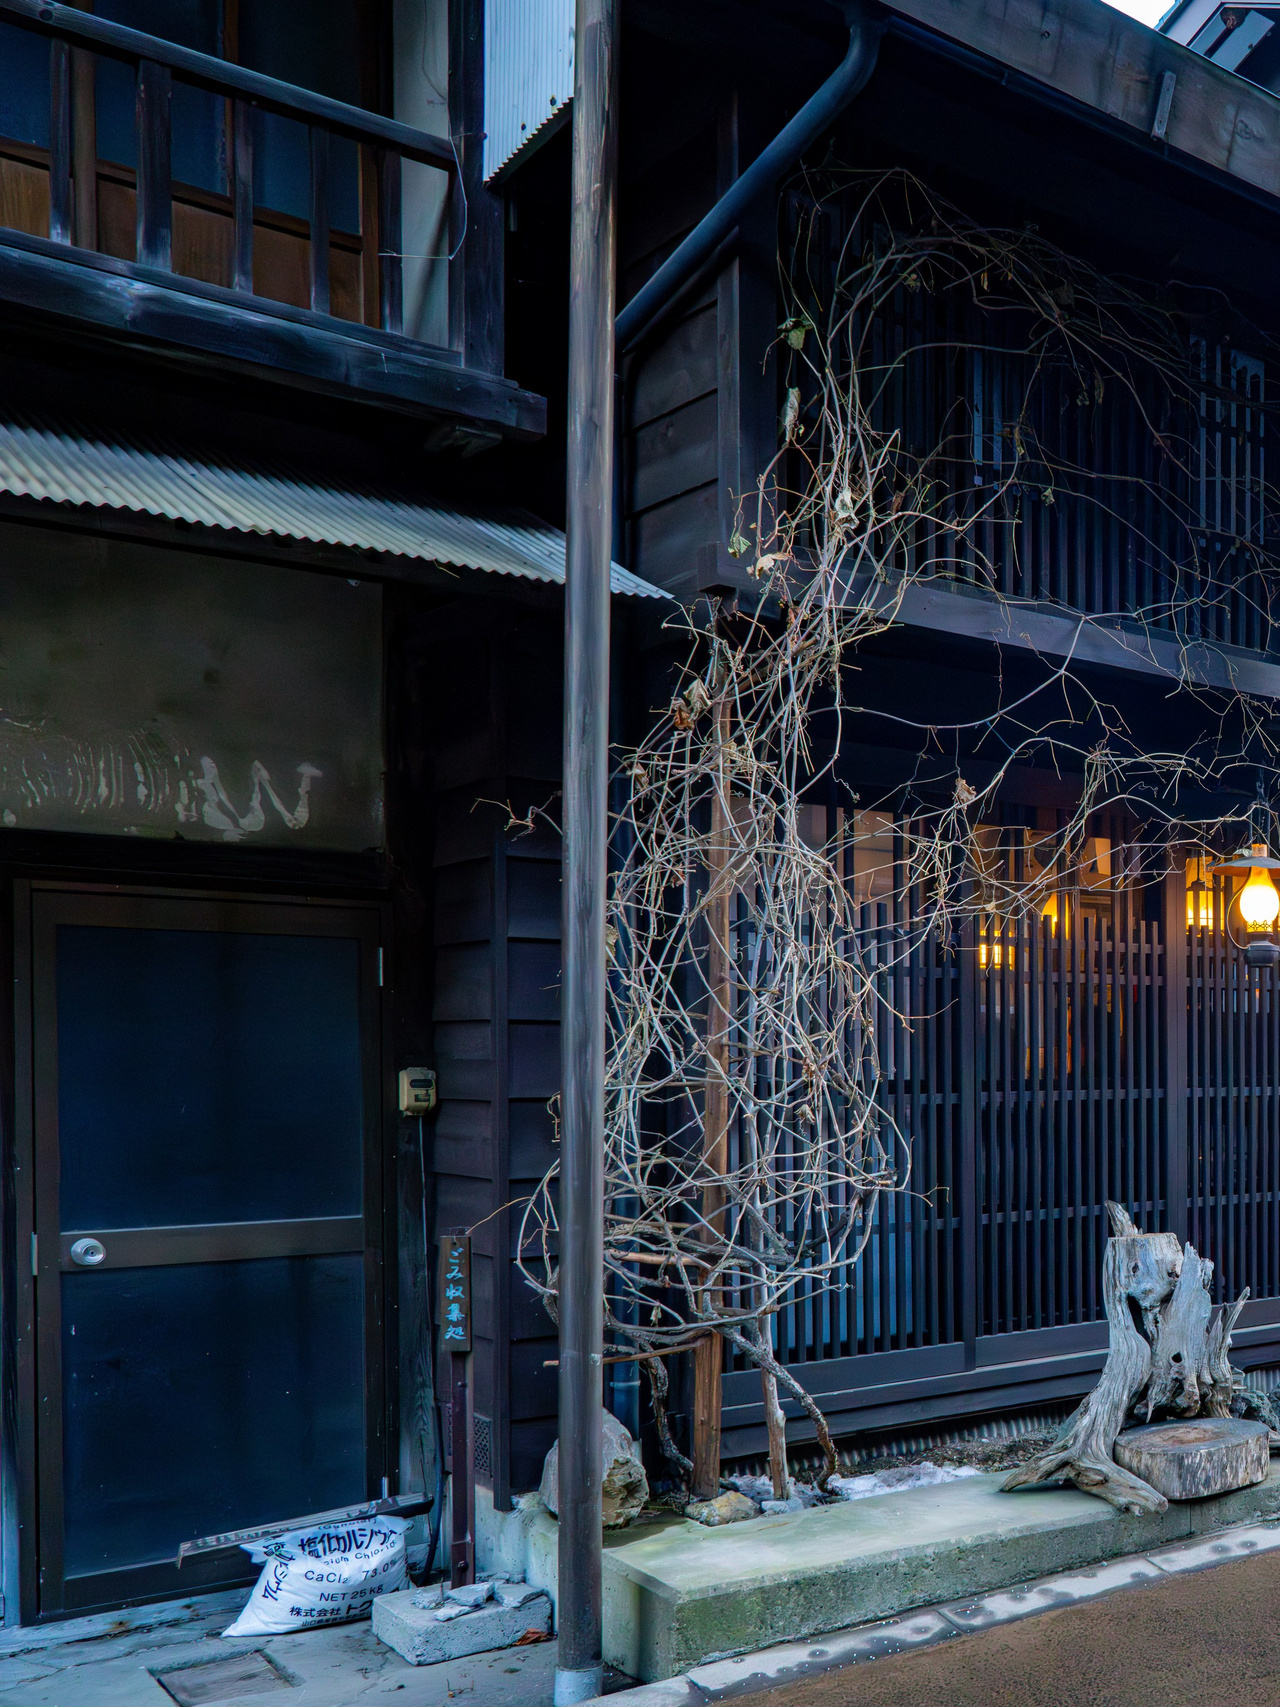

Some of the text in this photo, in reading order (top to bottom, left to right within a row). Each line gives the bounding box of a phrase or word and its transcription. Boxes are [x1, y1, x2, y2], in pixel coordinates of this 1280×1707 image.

[444, 1247, 466, 1340] ごみ収集処
[362, 1558, 399, 1582] 73.0%
[319, 1592, 349, 1602] NET
[350, 1590, 367, 1600] 25
[289, 1605, 342, 1618] 株式会社
